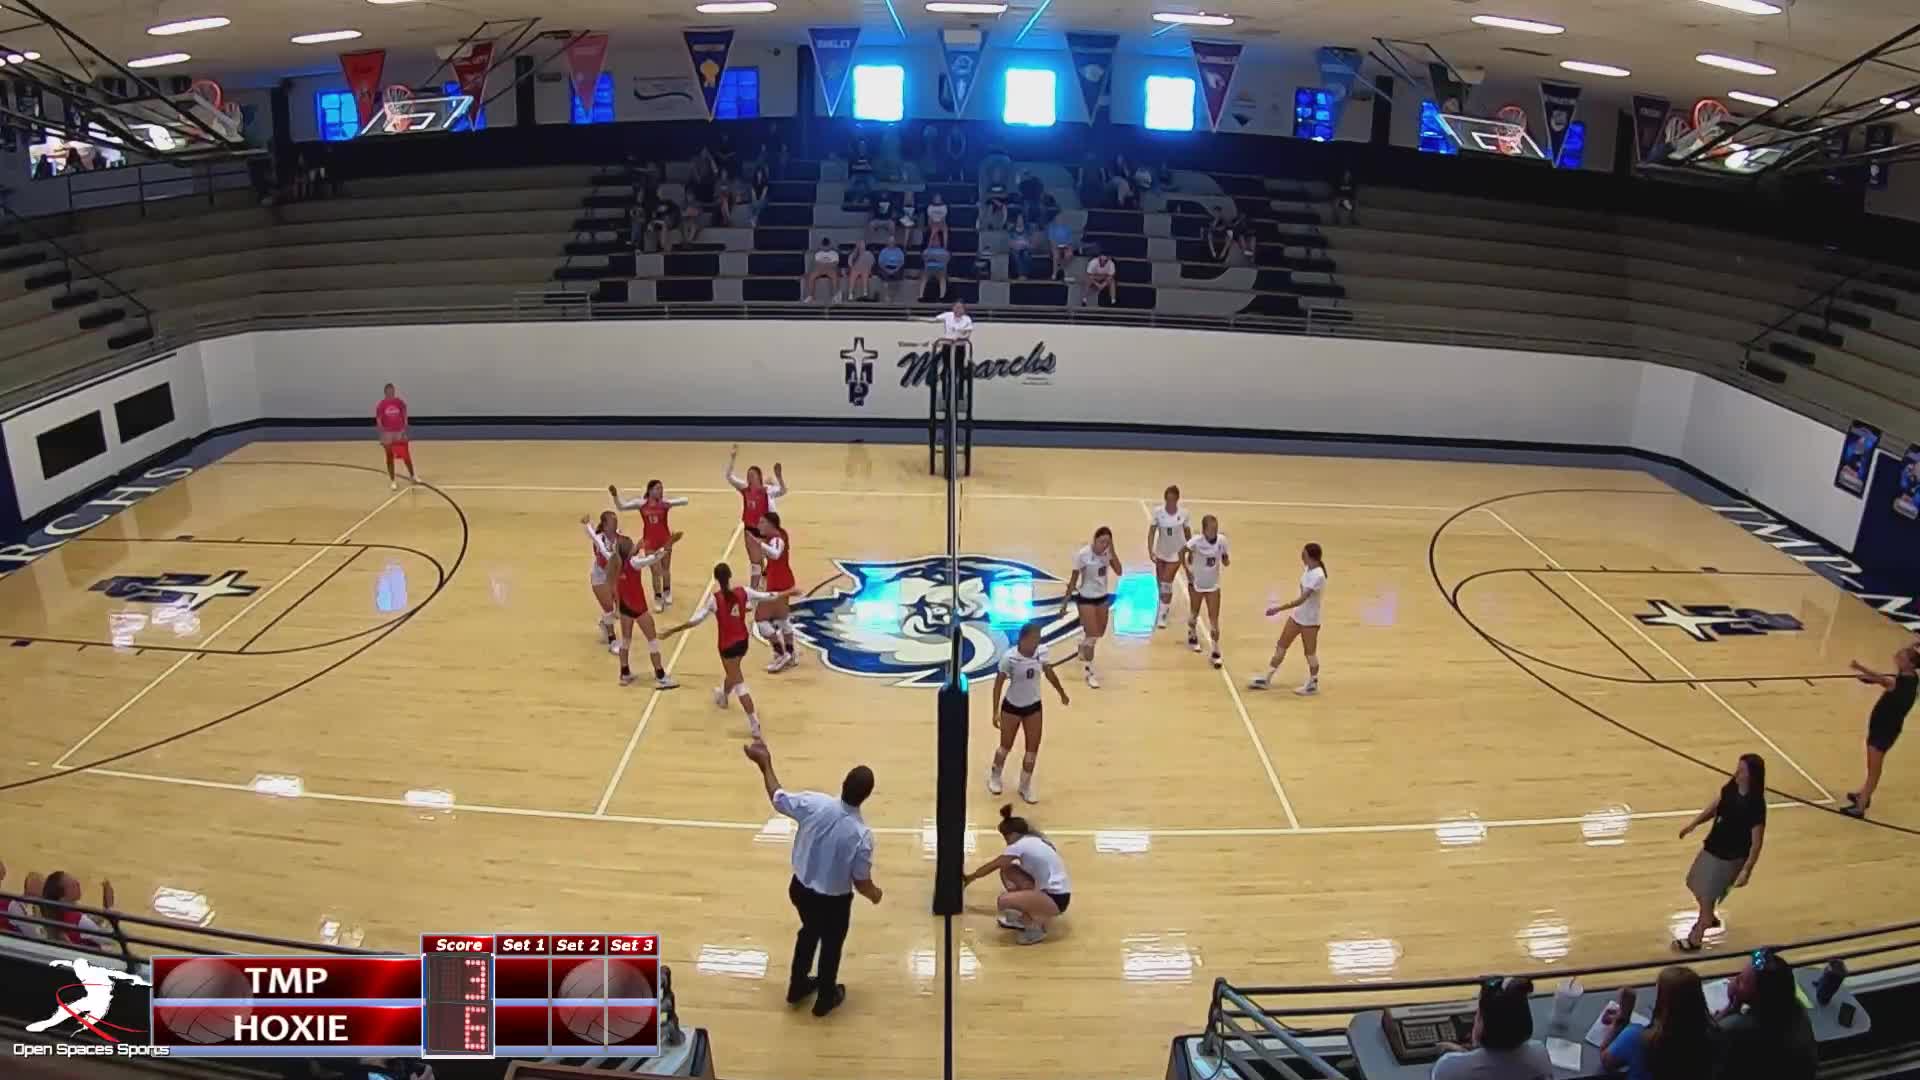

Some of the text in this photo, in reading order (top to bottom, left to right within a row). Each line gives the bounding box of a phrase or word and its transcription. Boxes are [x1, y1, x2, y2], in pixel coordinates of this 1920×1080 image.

[897, 341, 1057, 388] Marchs
[0, 467, 192, 577] RCHS
[730, 606, 741, 617] 4
